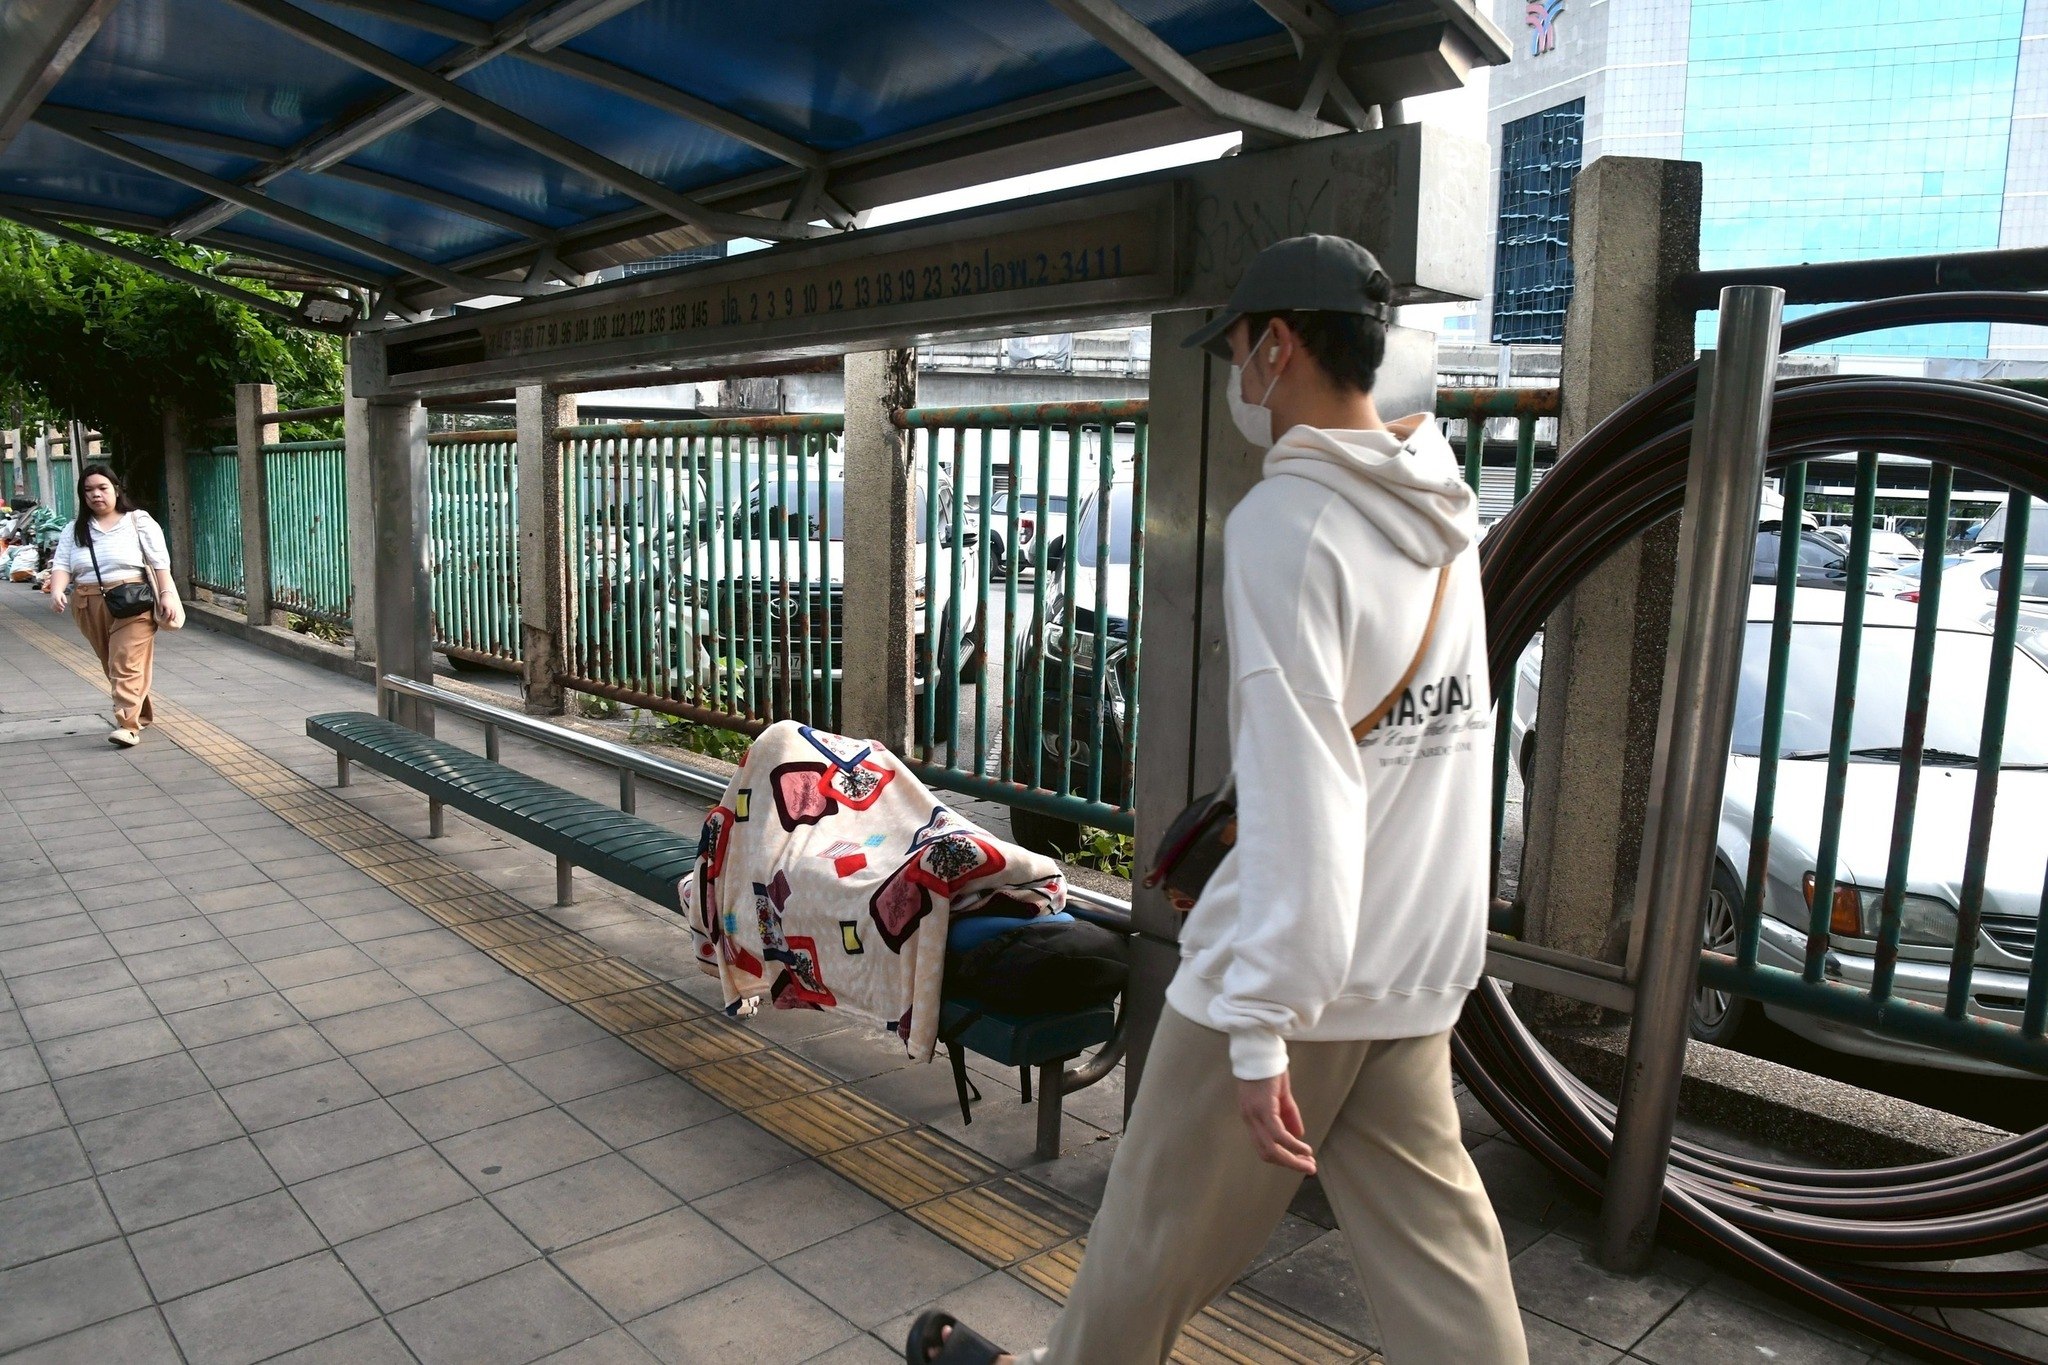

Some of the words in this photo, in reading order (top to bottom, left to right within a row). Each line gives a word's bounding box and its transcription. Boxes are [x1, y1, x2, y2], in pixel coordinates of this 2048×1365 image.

[537, 325, 546, 347] 77
[548, 323, 558, 346] 90
[561, 320, 572, 344] 96
[575, 319, 589, 342] 104
[593, 315, 607, 340] 108
[611, 313, 626, 337] 112
[629, 310, 646, 335] 122
[649, 306, 665, 333] 136
[670, 304, 687, 331] 138
[691, 301, 708, 329] 145
[750, 292, 759, 321] 2
[767, 290, 776, 319] 3
[785, 287, 794, 315] 9
[804, 283, 818, 313] 10
[828, 279, 843, 311] 12
[854, 276, 870, 307] 13
[876, 272, 892, 304] 18
[899, 269, 915, 302] 19
[923, 265, 942, 299] 23
